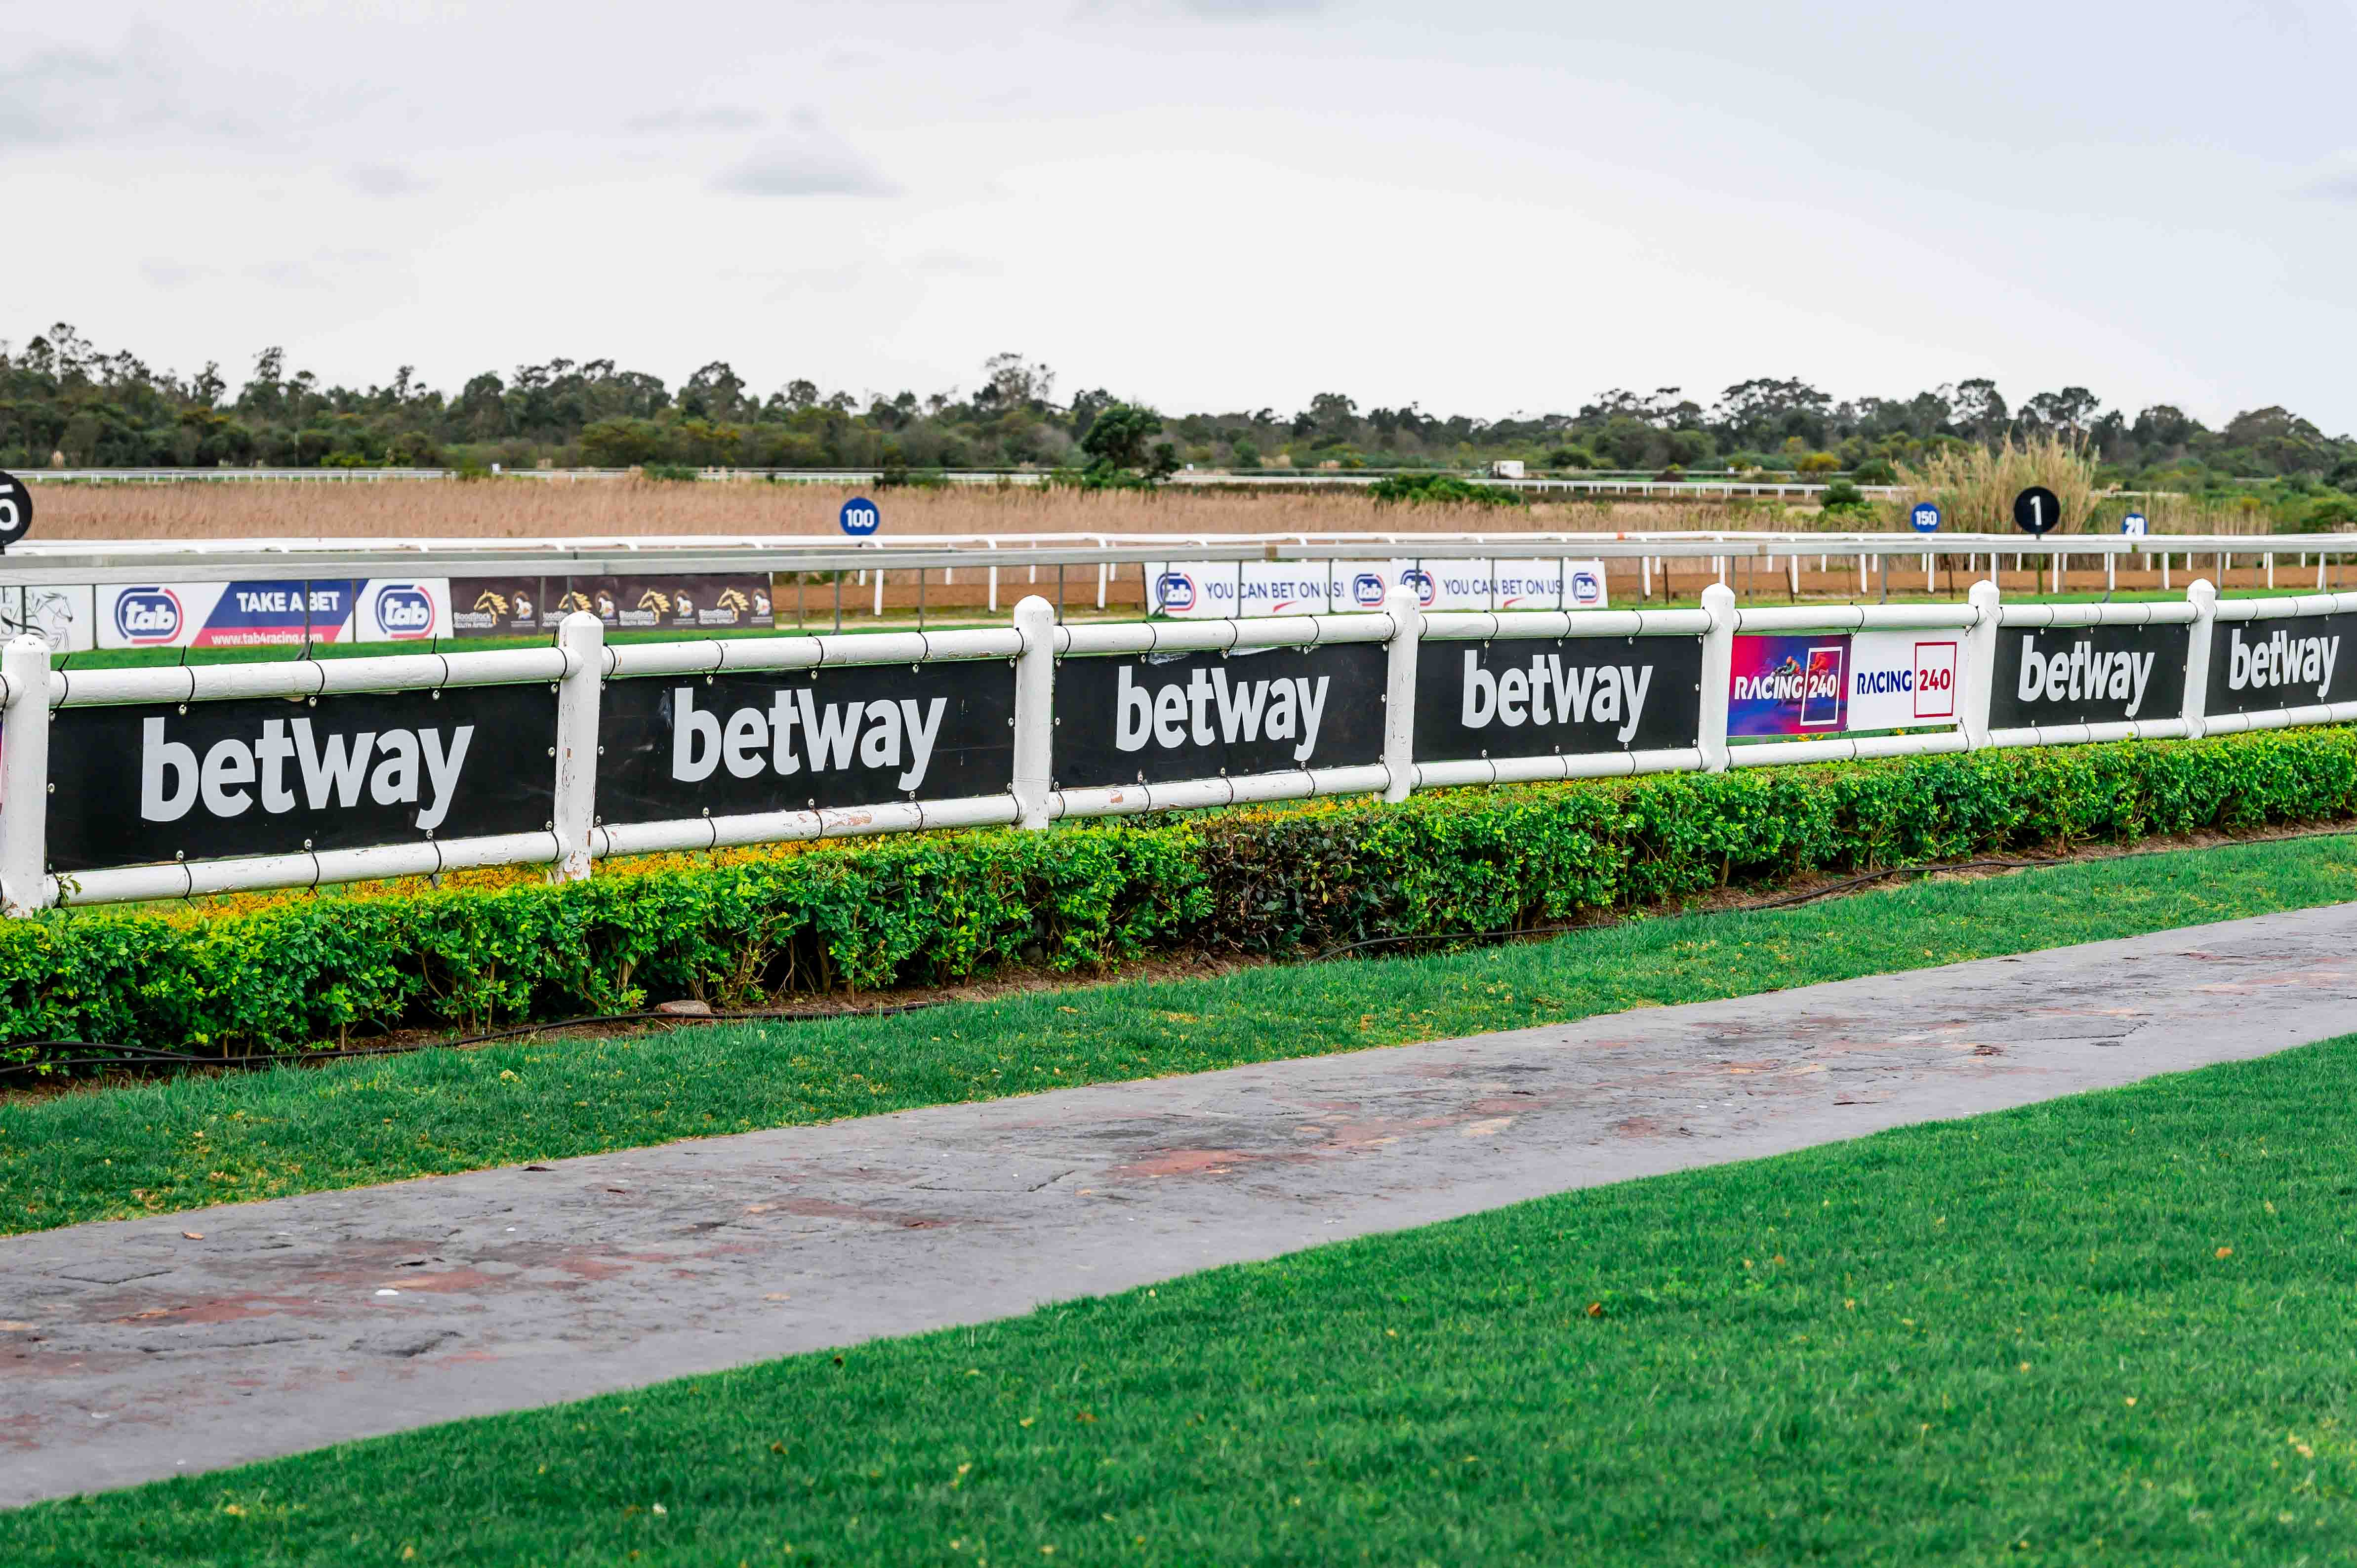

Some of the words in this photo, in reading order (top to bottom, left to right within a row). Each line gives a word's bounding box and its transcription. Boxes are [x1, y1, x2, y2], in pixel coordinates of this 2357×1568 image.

[846, 509, 875, 527] 100
[1914, 511, 1937, 526] 150
[2030, 495, 2042, 526] 1
[1205, 582, 1233, 599] YOU
[1240, 582, 1268, 599] CAN
[1272, 581, 1297, 598] BET
[1300, 581, 1320, 598] ON
[1358, 581, 1382, 599] tab
[1444, 579, 1469, 595] YOU
[1473, 579, 1499, 595] CAN
[1503, 580, 1523, 595] BET
[1526, 580, 1544, 595] ON
[125, 601, 175, 630] tab
[236, 592, 286, 613] TAKE
[289, 592, 304, 612] A
[309, 591, 340, 612] BET
[385, 598, 428, 626] tab
[2018, 635, 2155, 719] betway
[2229, 628, 2340, 702] betway
[1734, 676, 1803, 700] RACING
[1808, 674, 1837, 699] 240
[1857, 670, 1912, 695] RACING
[1919, 668, 1951, 691] 240
[1462, 649, 1654, 743] betway
[1116, 665, 1330, 762] betway
[672, 687, 947, 791] betway
[141, 717, 475, 830] betway
